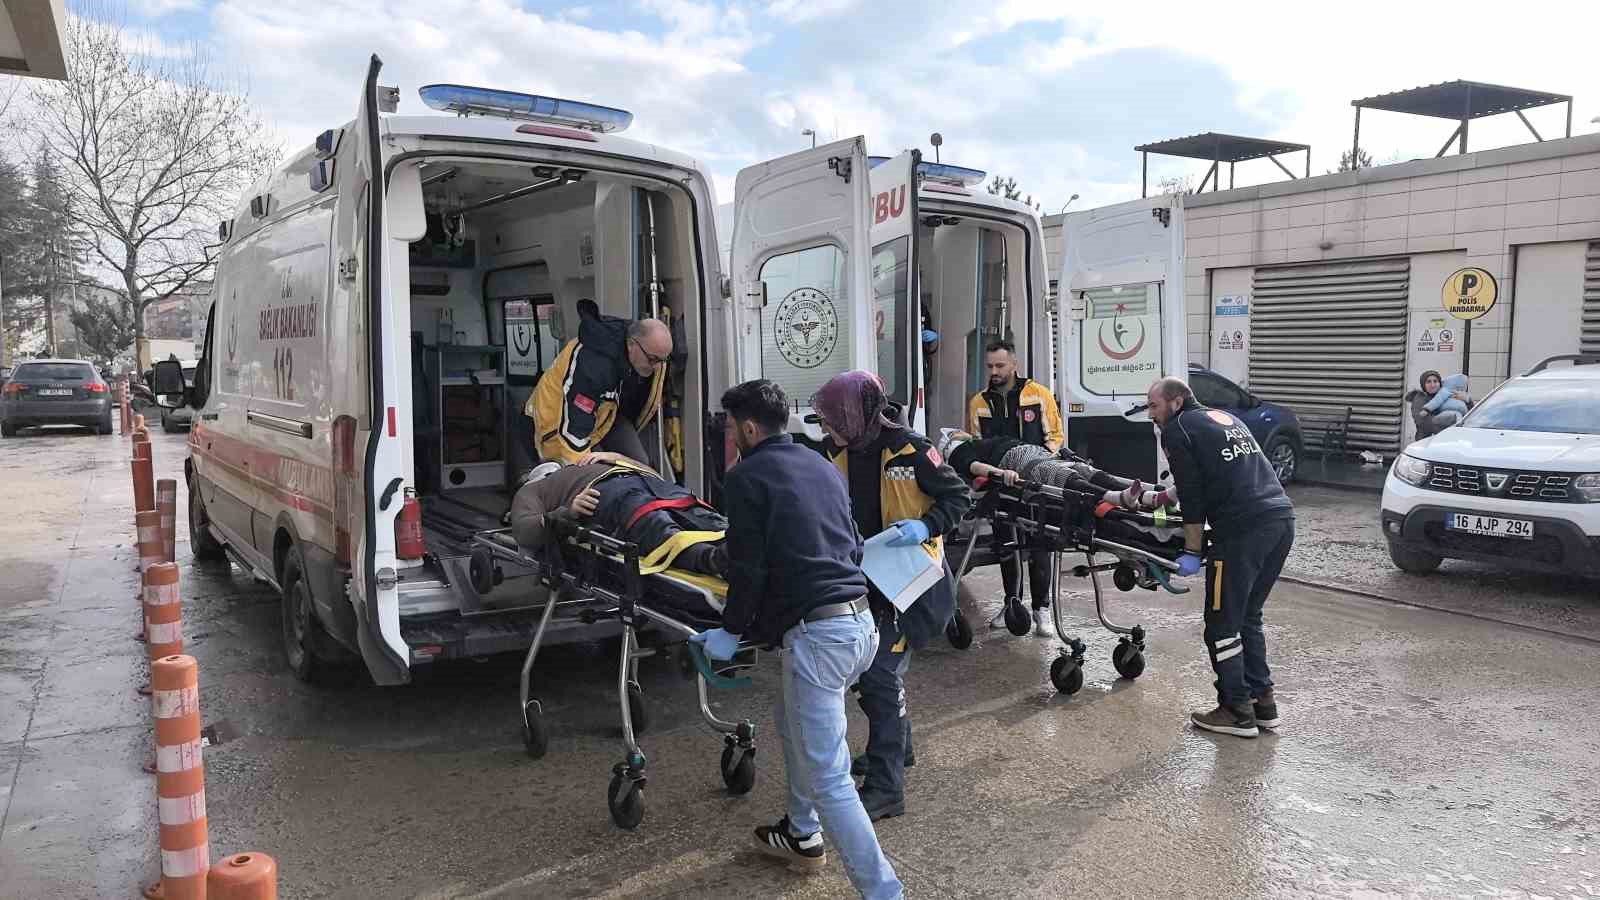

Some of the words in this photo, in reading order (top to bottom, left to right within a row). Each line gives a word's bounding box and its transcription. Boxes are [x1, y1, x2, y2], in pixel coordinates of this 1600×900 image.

[1461, 274, 1478, 295] P
[274, 347, 293, 400] 112
[1221, 440, 1261, 461] SAĞL
[1456, 515, 1469, 528] 16
[1475, 517, 1499, 531] AJP
[1506, 520, 1530, 536] 294
